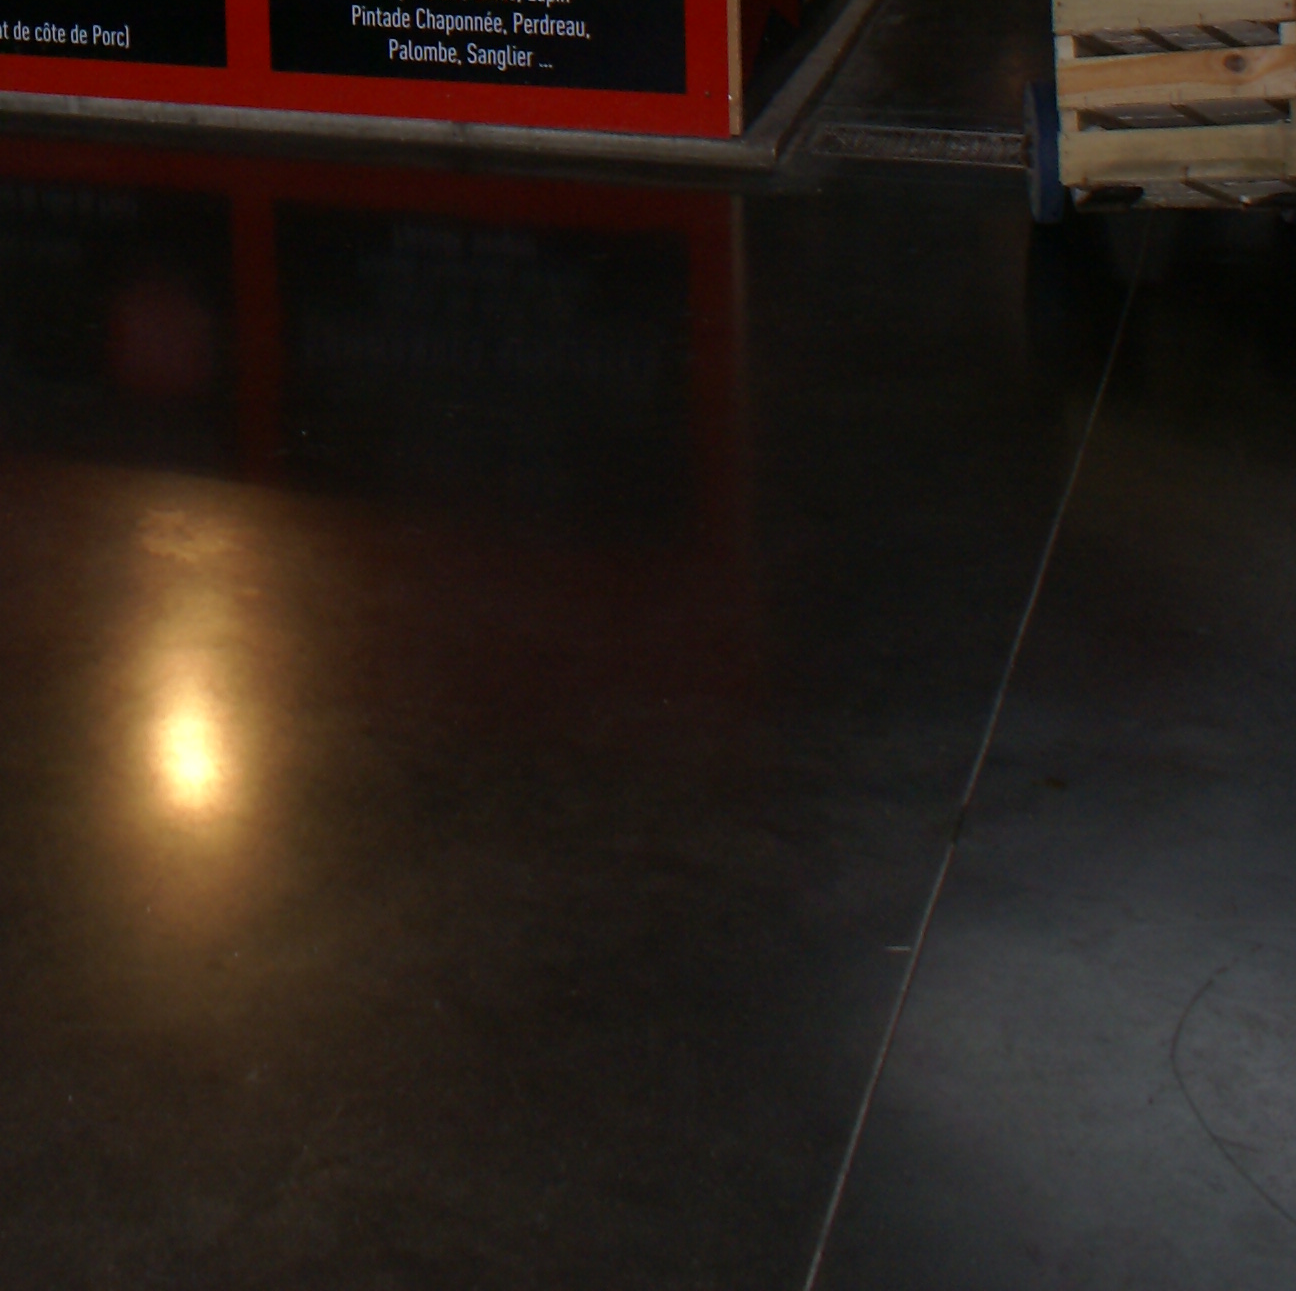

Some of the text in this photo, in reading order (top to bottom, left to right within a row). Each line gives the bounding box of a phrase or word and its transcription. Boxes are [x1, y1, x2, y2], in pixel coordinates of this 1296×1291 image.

[13, 20, 30, 41] de
[34, 22, 66, 43] côte
[70, 24, 88, 44] de
[92, 24, 130, 49] Porc)
[351, 4, 591, 40] Pintade Chaponnée, Perdreau,
[388, 38, 462, 65] Palombe,
[466, 42, 533, 71] Sanglier
